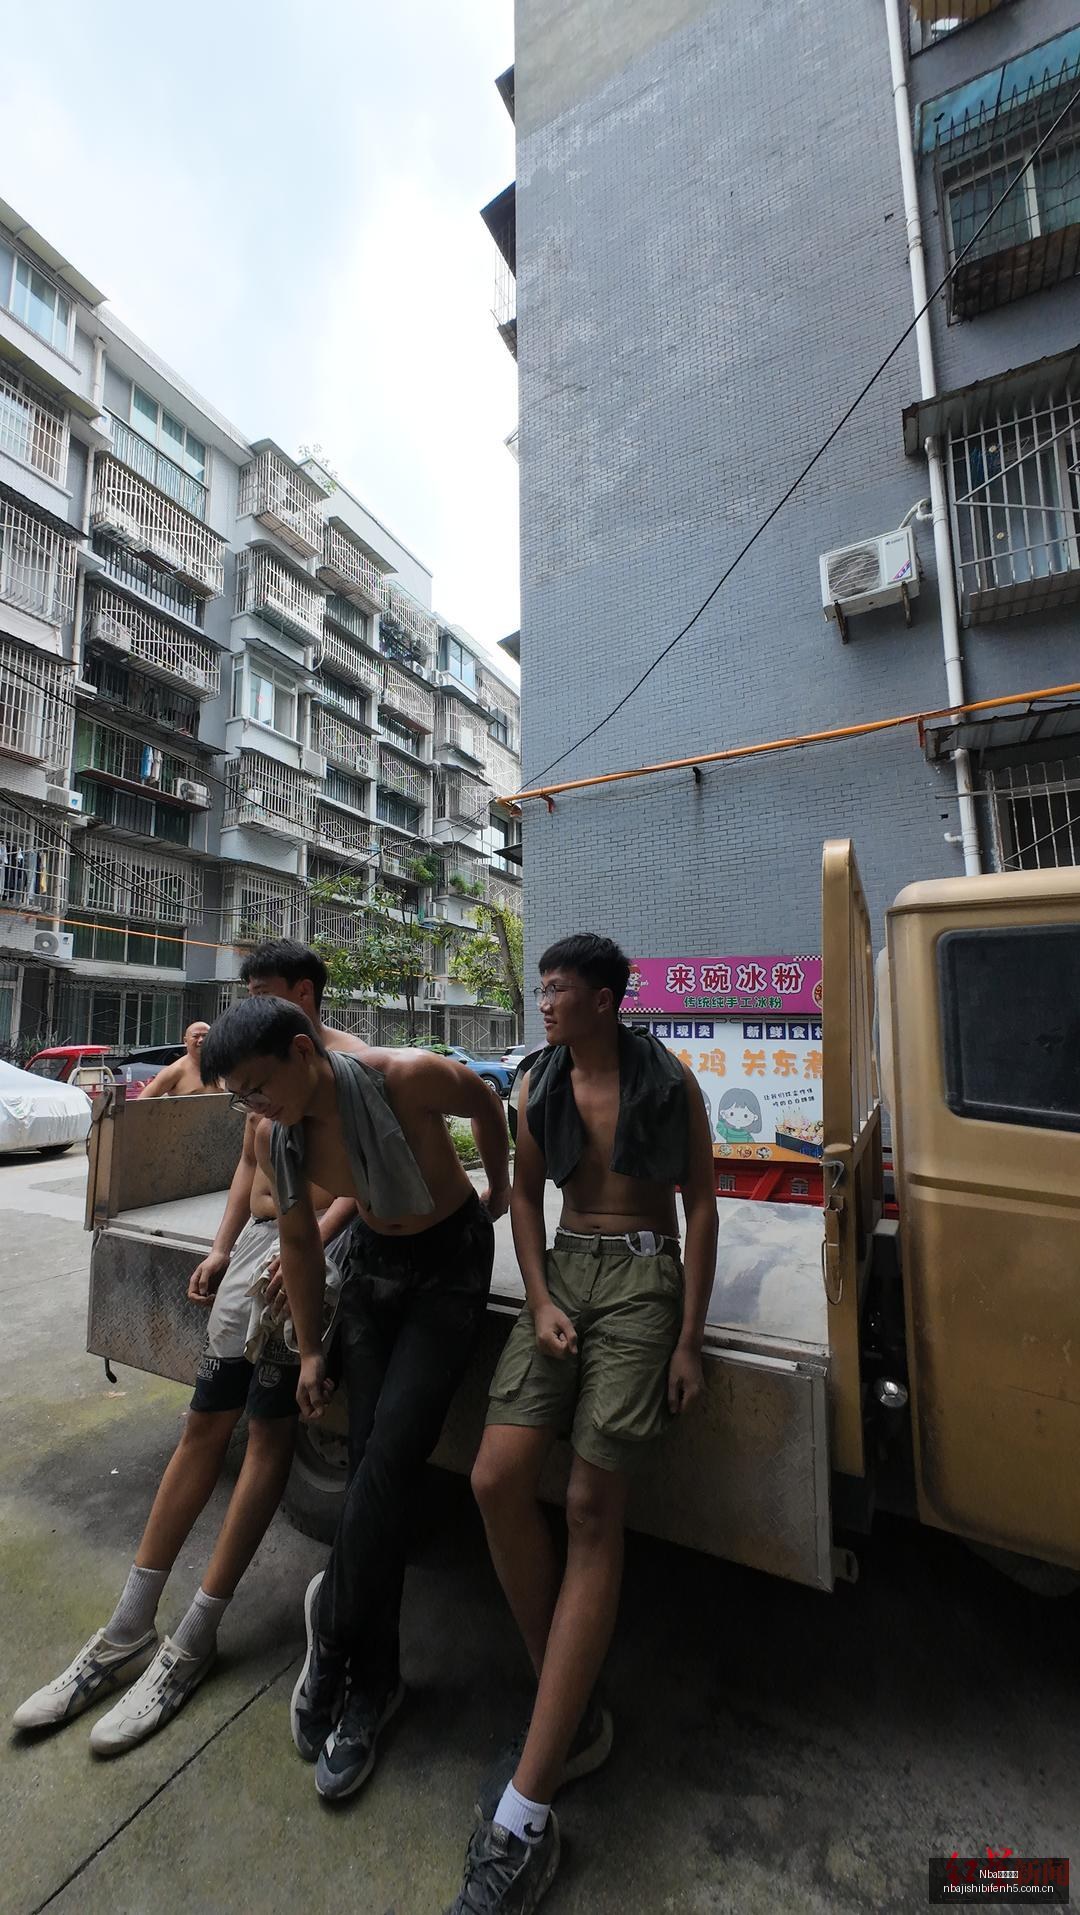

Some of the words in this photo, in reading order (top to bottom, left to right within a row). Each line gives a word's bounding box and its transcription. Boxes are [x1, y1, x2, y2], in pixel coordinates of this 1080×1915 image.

[666, 963, 805, 994] 来碗冰粉
[683, 996, 783, 1009] 传统纯手工冰粉
